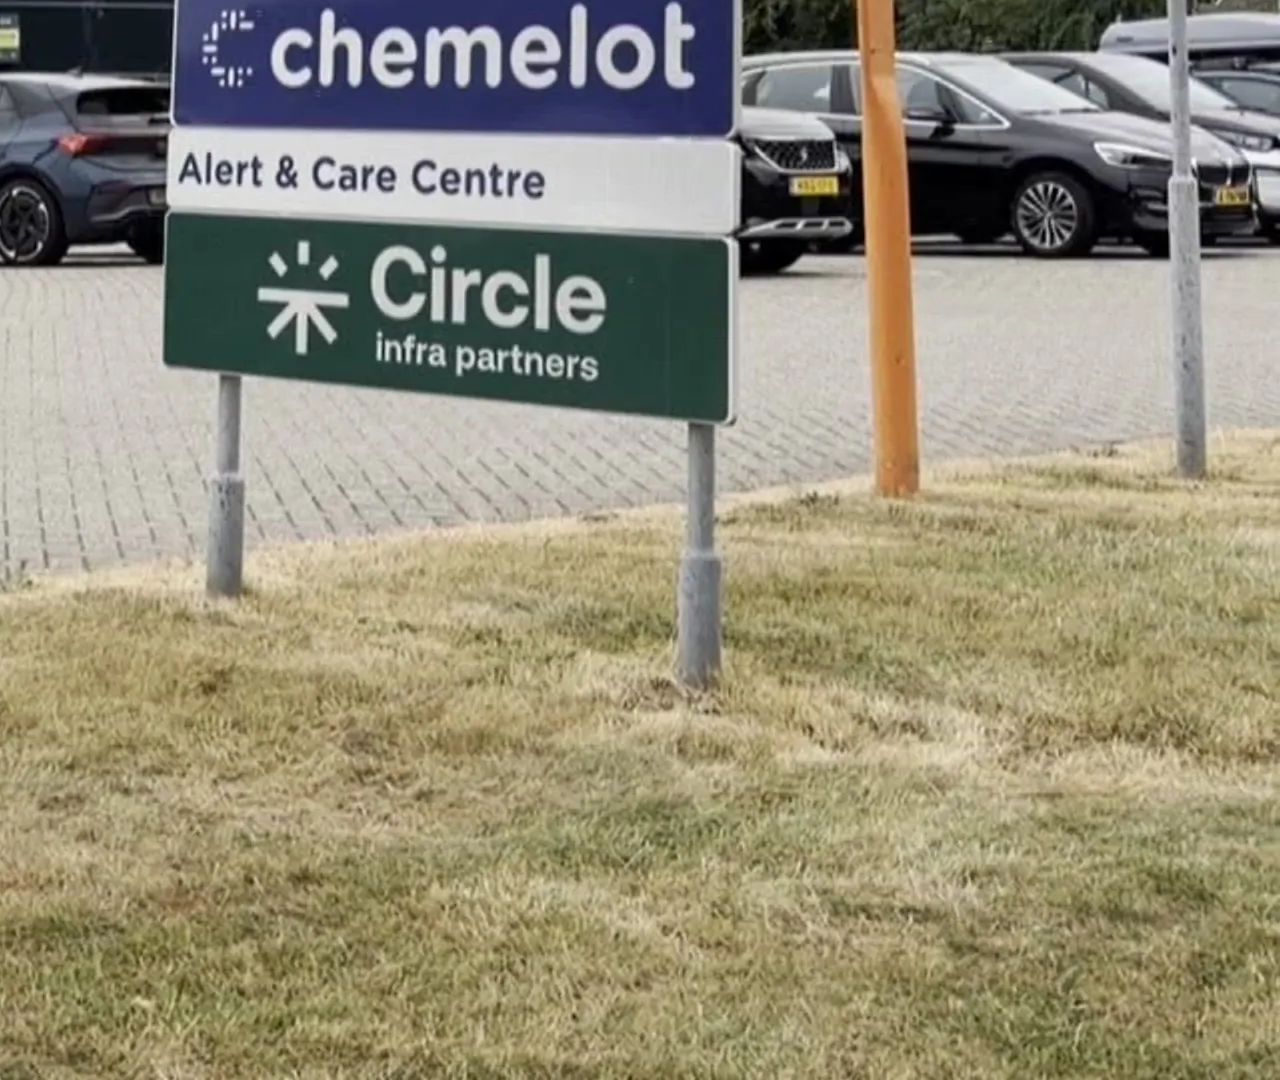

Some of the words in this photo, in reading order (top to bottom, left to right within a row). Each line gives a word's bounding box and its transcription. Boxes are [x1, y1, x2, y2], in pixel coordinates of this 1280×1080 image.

[270, 1, 696, 90] chemelot
[178, 152, 263, 188] Alert
[275, 155, 299, 189] &
[312, 155, 397, 193] Care
[411, 160, 546, 199] Centre
[370, 244, 607, 335] Circle
[376, 332, 446, 367] infra
[456, 339, 600, 381] partners
